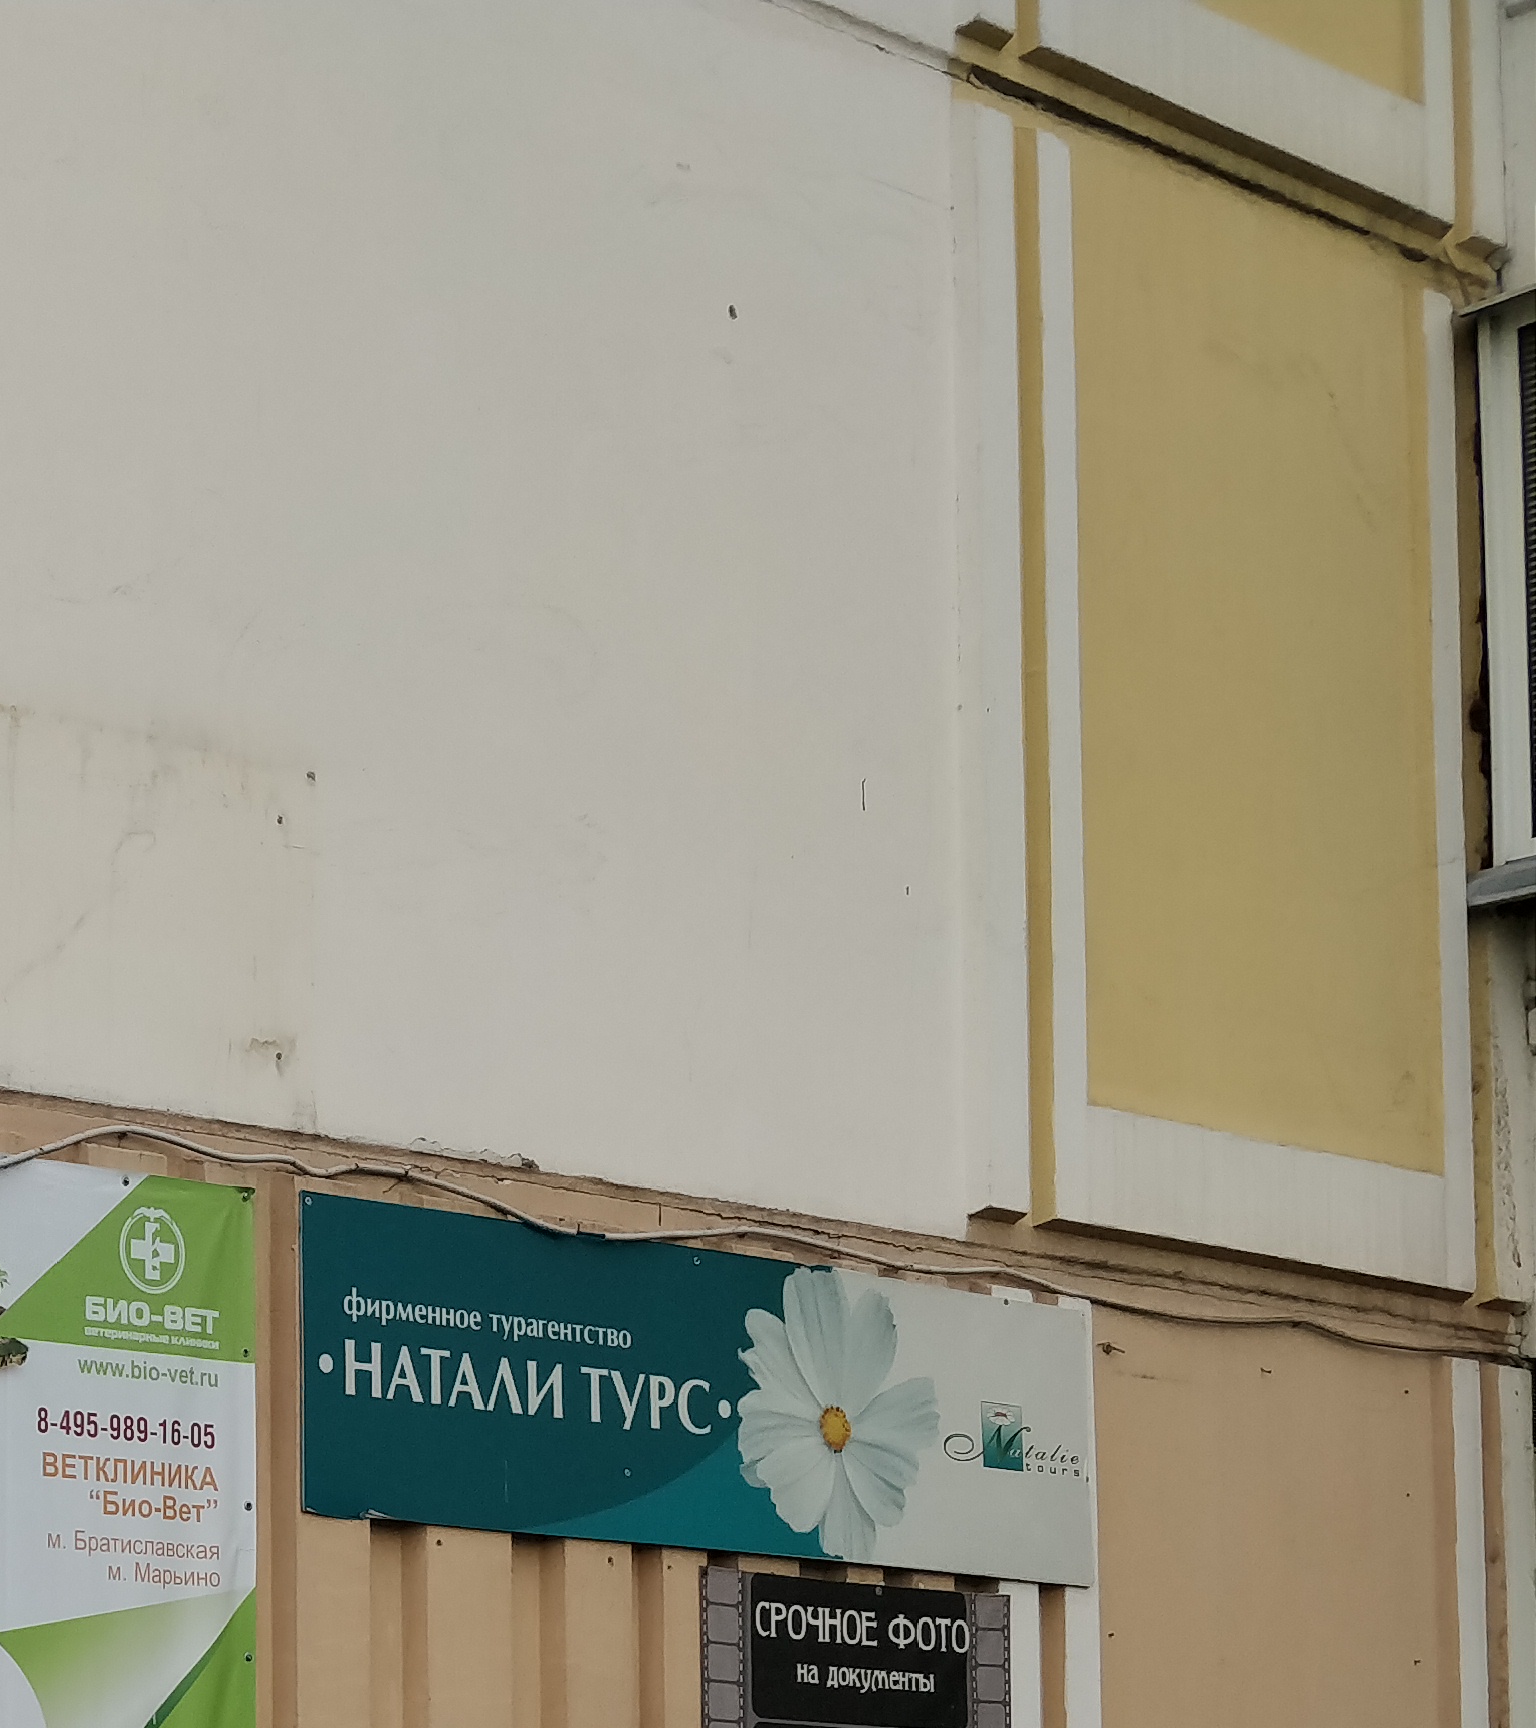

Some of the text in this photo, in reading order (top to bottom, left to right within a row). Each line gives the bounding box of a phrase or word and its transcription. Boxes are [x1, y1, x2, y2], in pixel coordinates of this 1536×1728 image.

[85, 1296, 220, 1334] БИО-ВЕТ
[343, 1287, 633, 1349] фирменное турагентство
[84, 1326, 220, 1350] ветеринарные клиники
[77, 1359, 219, 1388] www.bio-vet.ru
[343, 1338, 713, 1435] НАТАЛИ ТУРС
[37, 1407, 216, 1450] 8-495-989-16-05
[943, 1426, 1080, 1465] Natalie
[42, 1451, 219, 1493] ВЕТКЛИНИКА
[1025, 1462, 1080, 1478] tours
[89, 1488, 219, 1524] “Био-Вет”
[47, 1530, 221, 1562] м. Братиславская
[107, 1561, 222, 1590] м. Марьино
[754, 1601, 971, 1655] СРОЧНОЕ ФОТО
[796, 1663, 936, 1694] на документы
